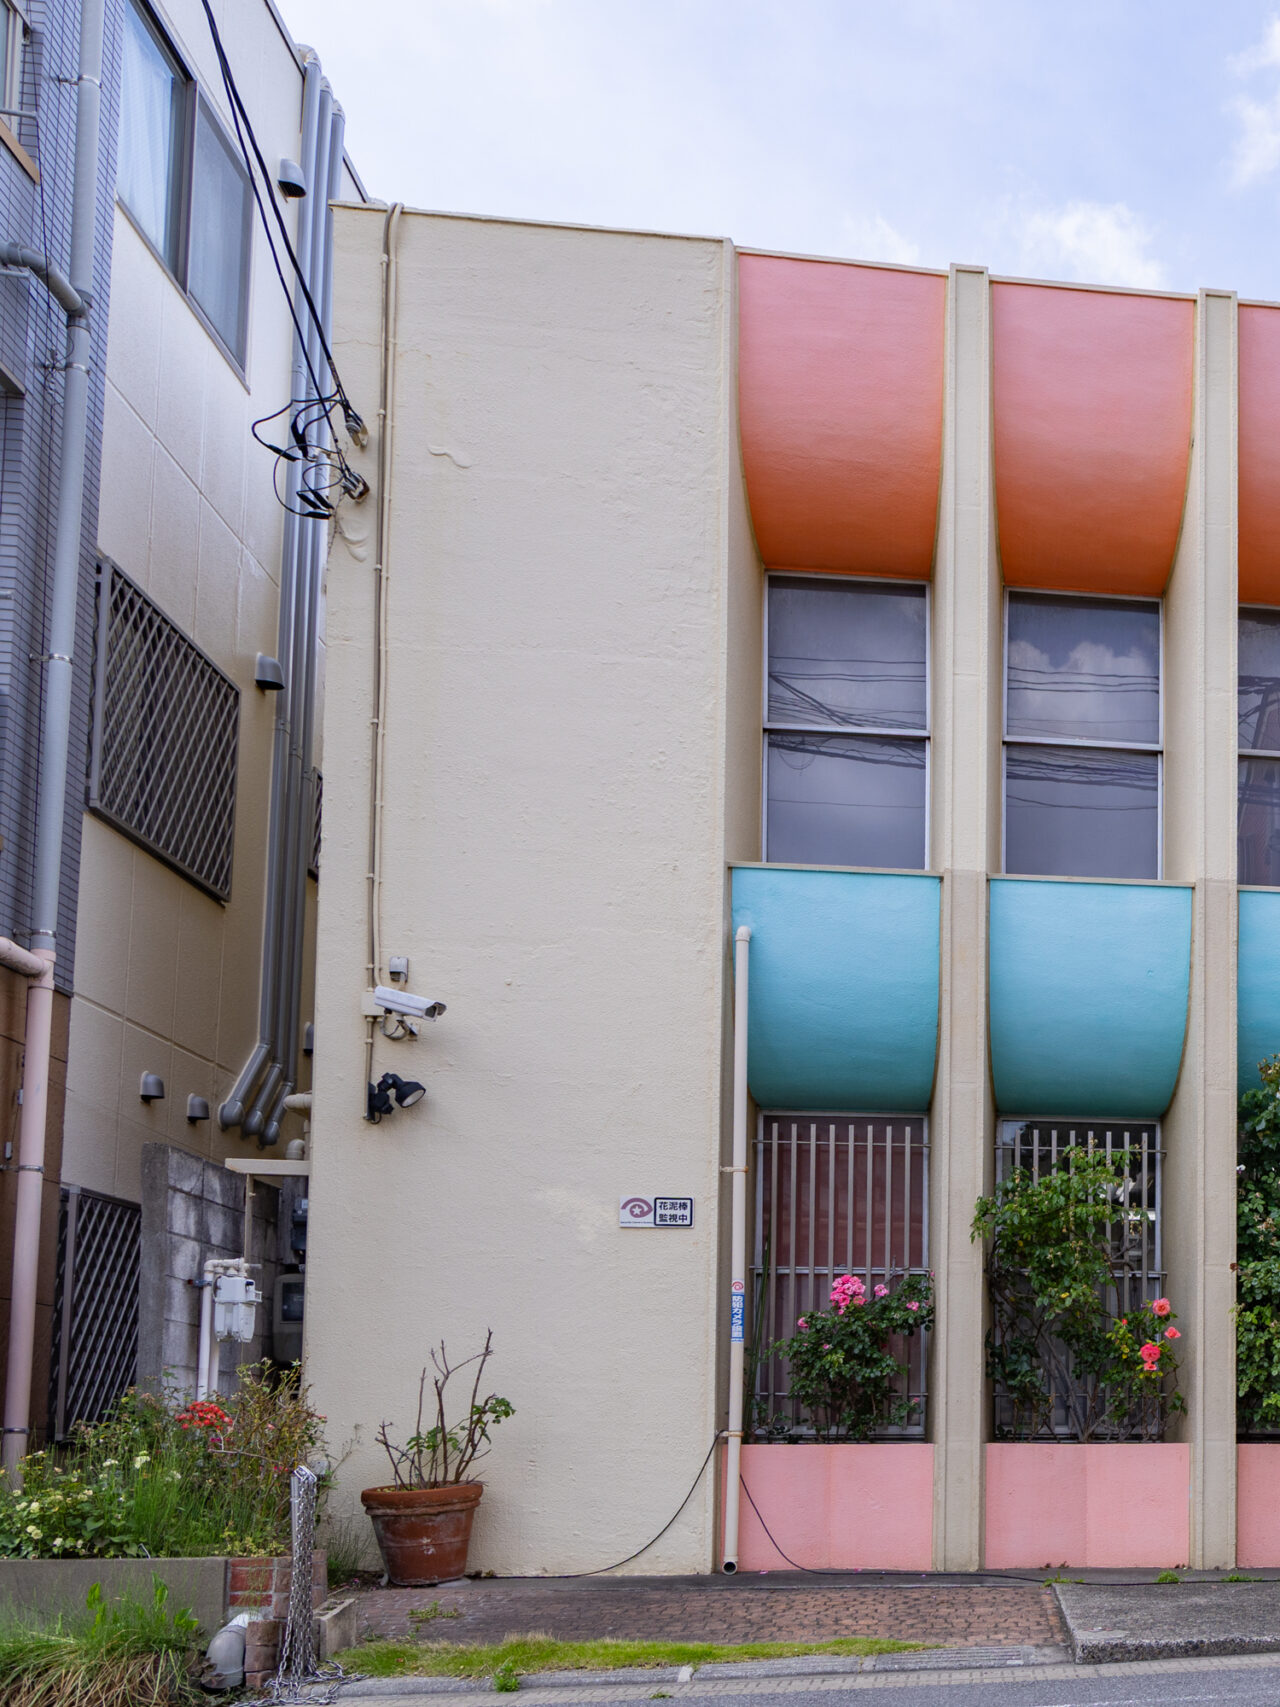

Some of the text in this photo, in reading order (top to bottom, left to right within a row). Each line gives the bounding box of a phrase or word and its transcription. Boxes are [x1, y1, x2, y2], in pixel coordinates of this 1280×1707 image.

[658, 1201, 688, 1211] 花泥棒
[658, 1213, 688, 1223] 監視中
